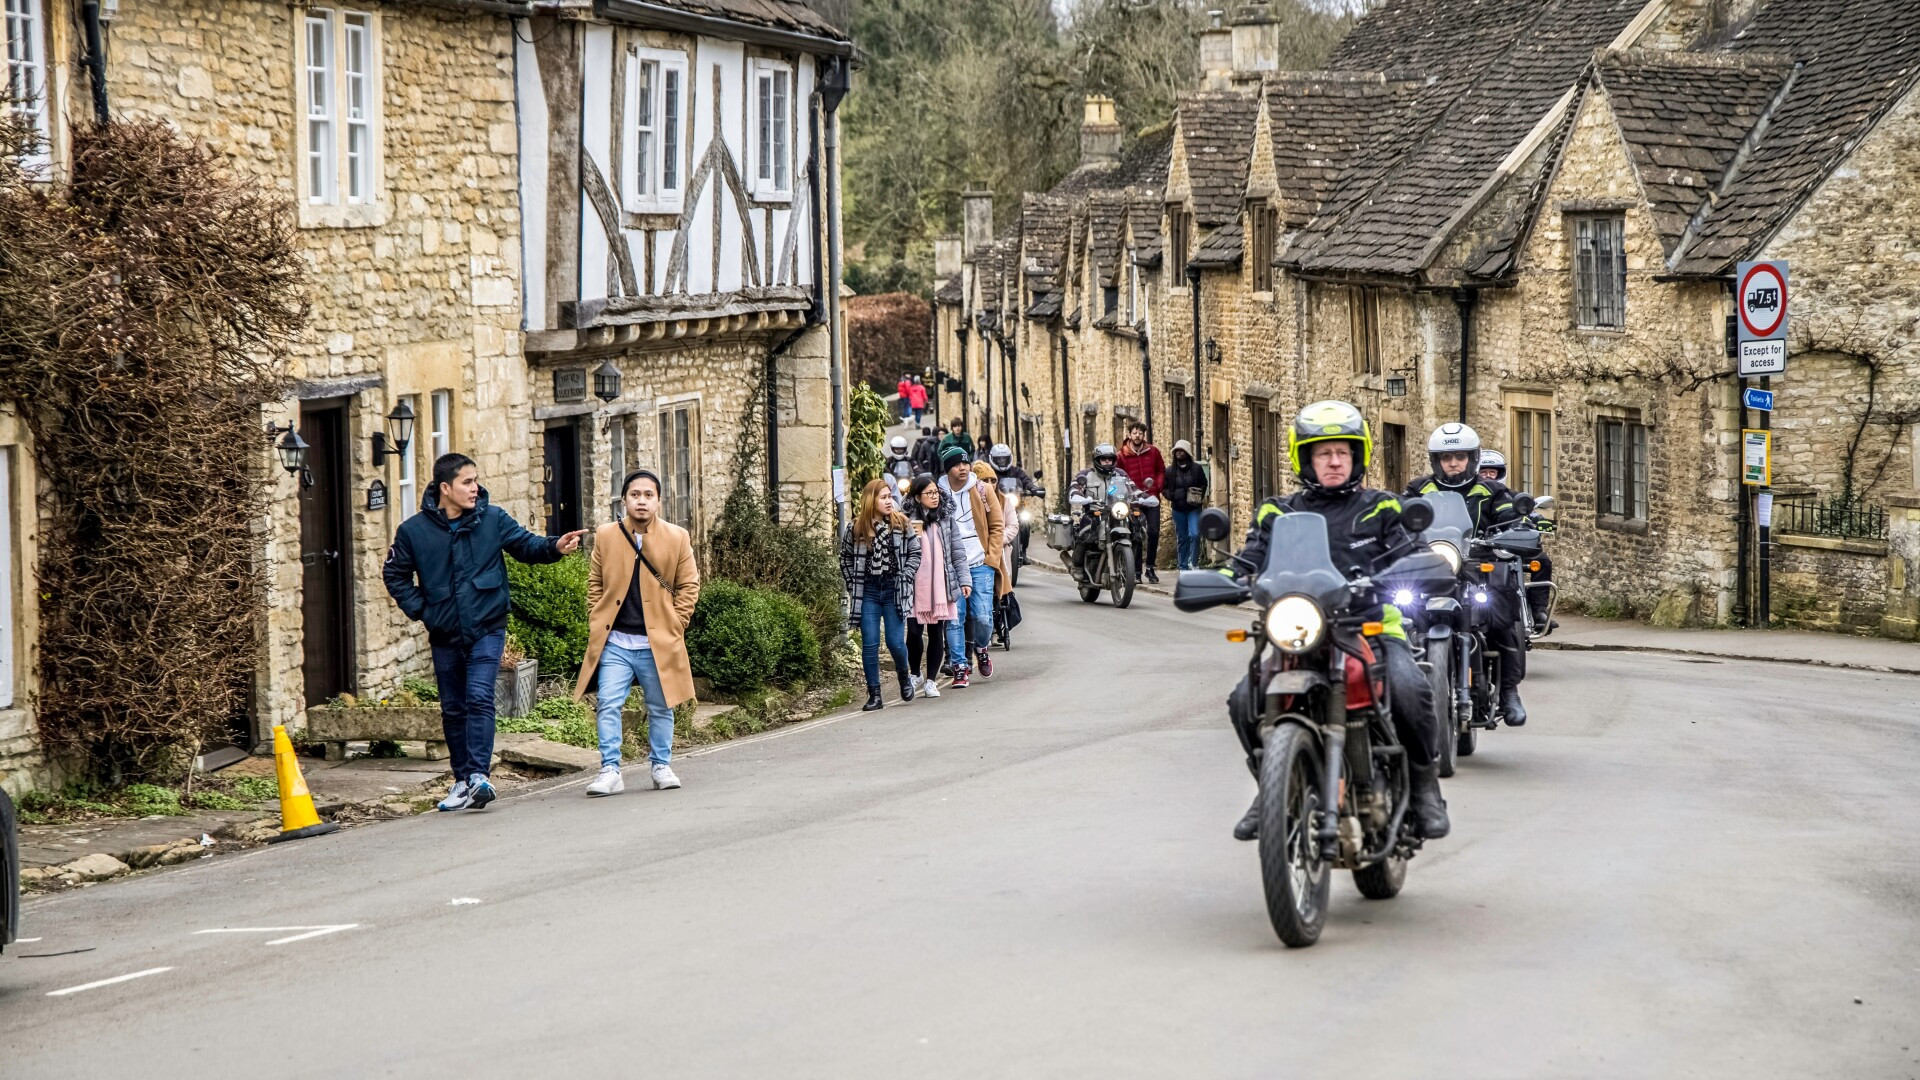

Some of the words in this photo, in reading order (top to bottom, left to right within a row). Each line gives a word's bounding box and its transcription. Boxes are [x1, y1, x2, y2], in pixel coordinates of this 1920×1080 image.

[1744, 345, 1769, 356] Except
[1771, 344, 1781, 354] for
[1750, 358, 1775, 367] access
[1750, 394, 1764, 403] Toilets
